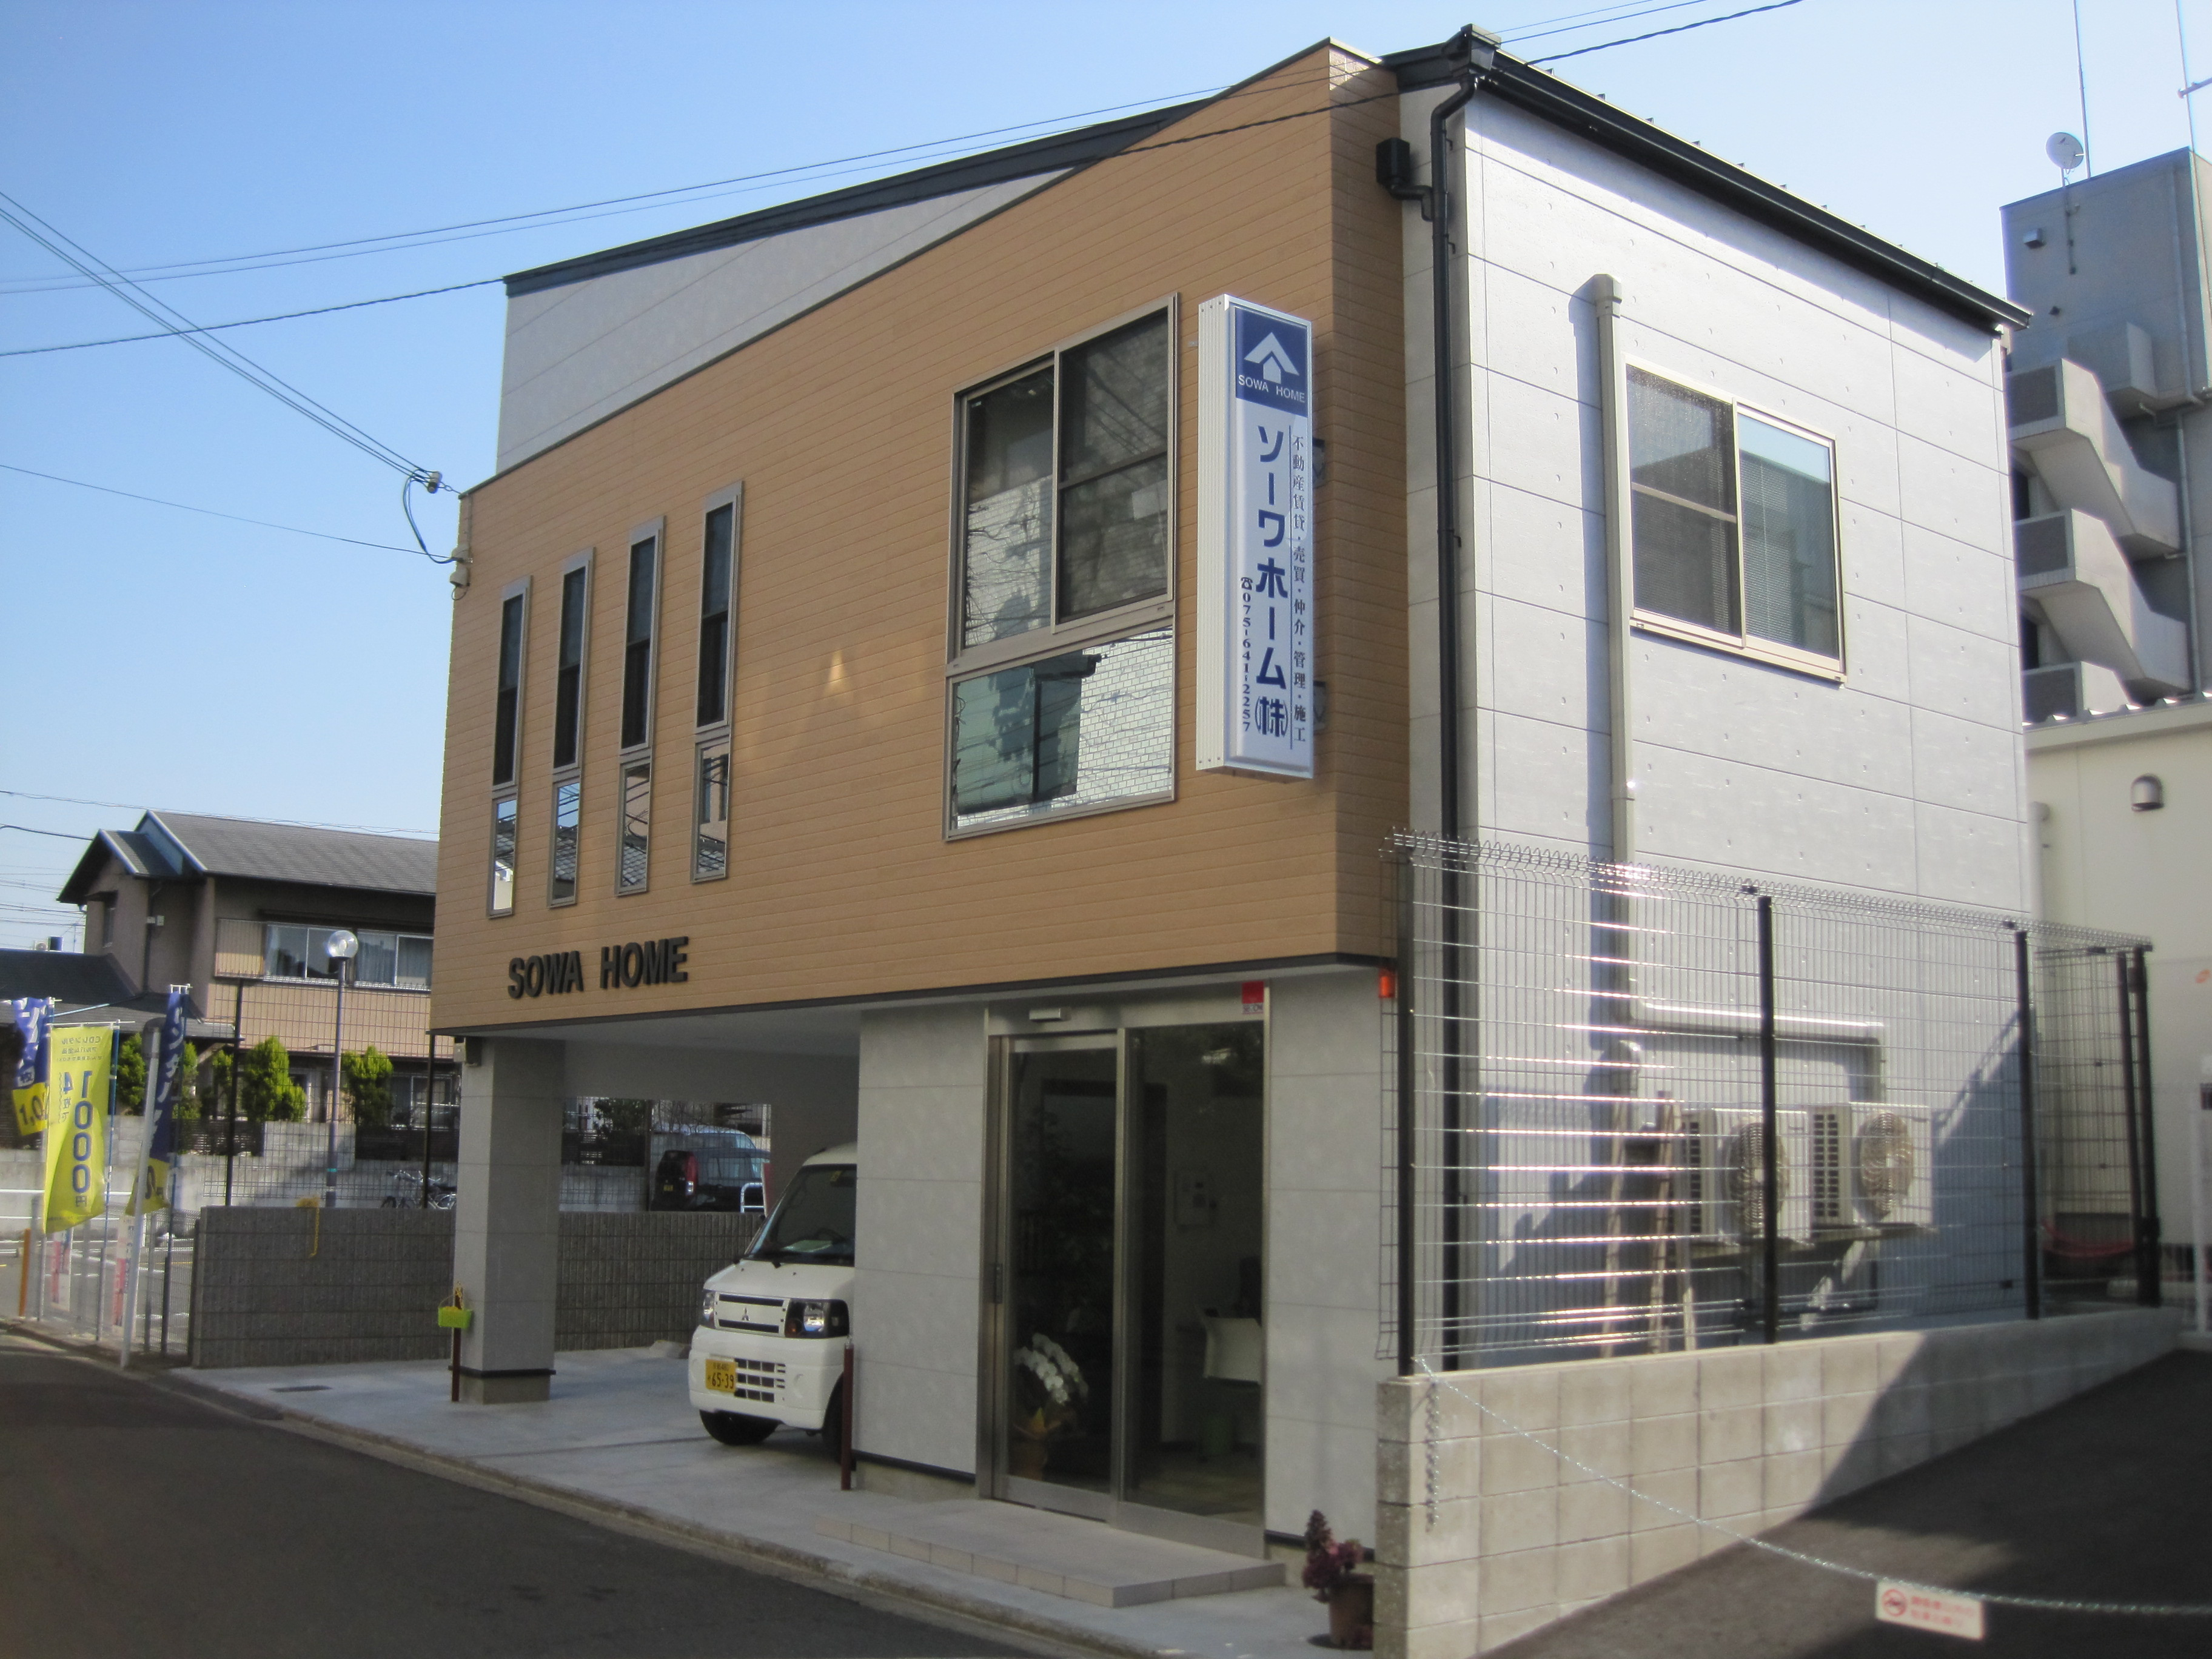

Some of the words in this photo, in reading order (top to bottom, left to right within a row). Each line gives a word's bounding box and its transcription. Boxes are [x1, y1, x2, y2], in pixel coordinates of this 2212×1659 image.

[1238, 374, 1269, 392] SOWA
[1276, 385, 1305, 403] HOME
[508, 950, 584, 999] SOWA
[600, 936, 689, 989] HOME
